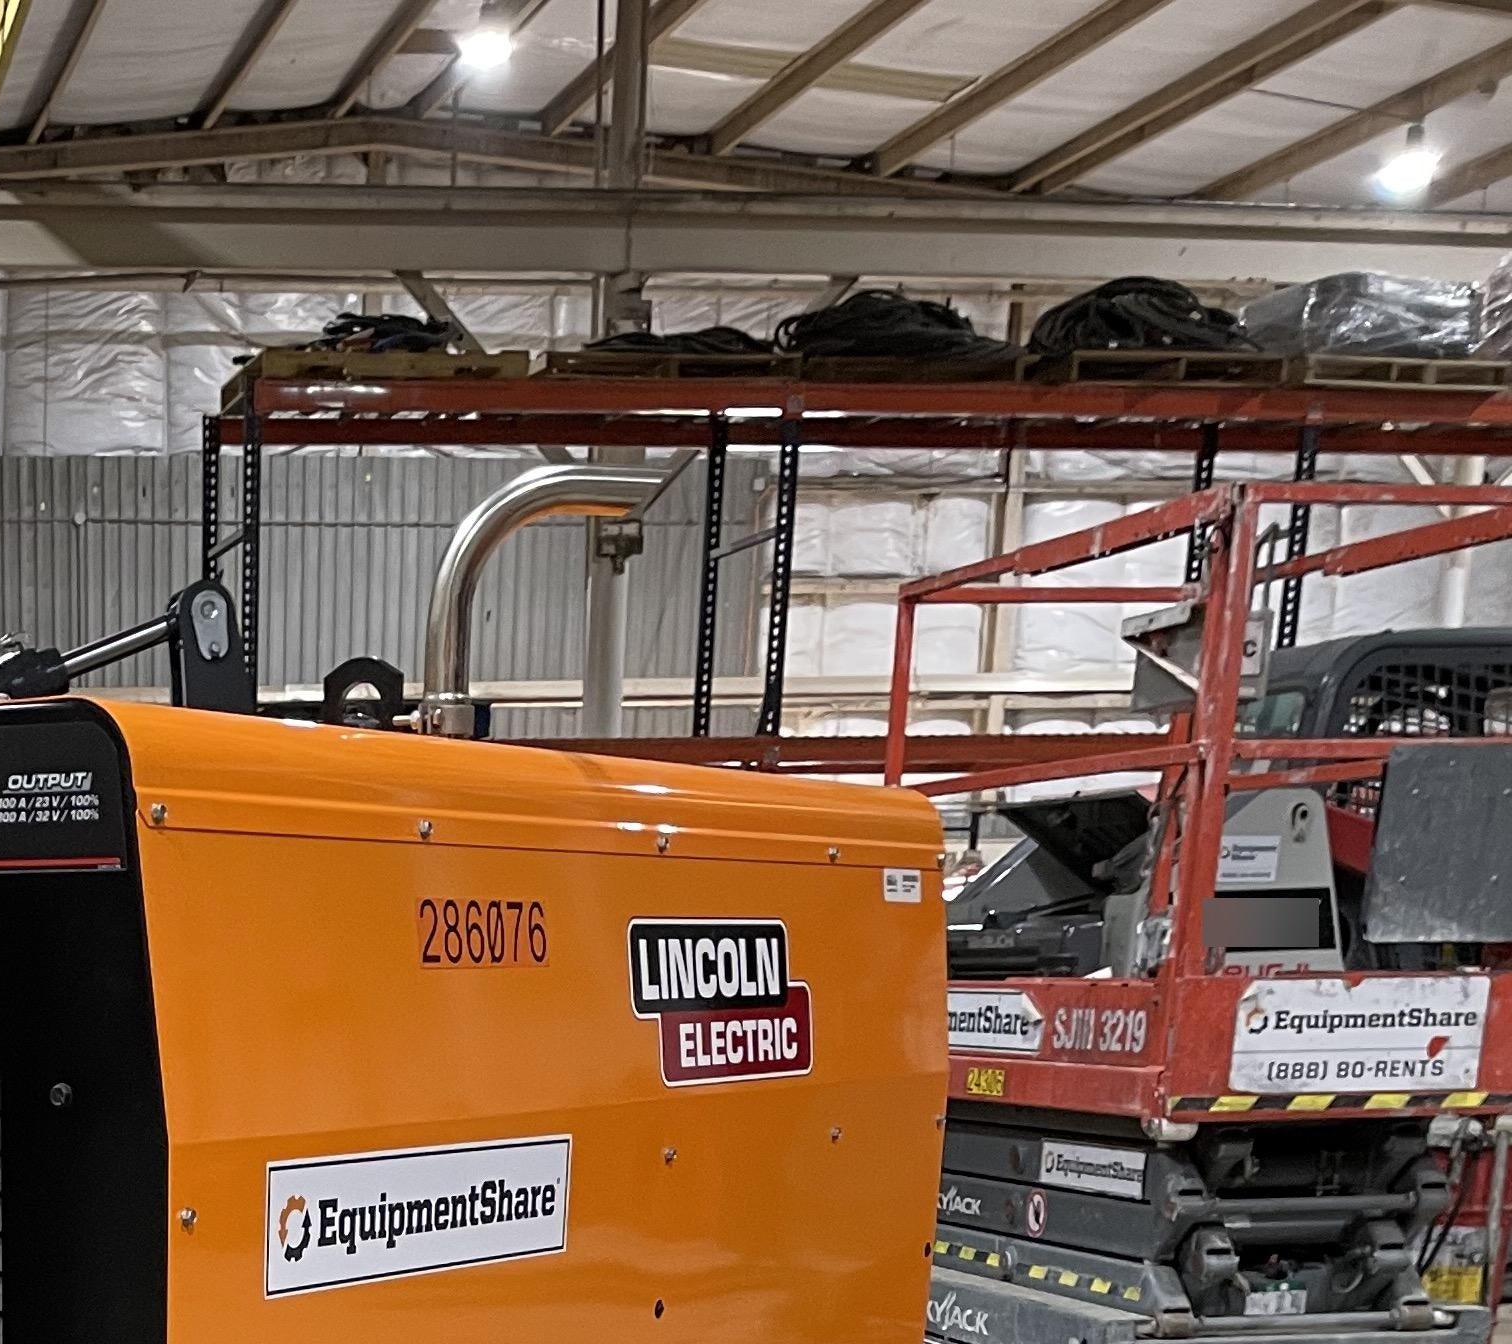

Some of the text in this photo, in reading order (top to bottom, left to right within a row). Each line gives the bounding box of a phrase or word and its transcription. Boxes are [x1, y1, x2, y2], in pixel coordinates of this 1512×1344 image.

[8, 772, 87, 789] OUTPUT
[419, 899, 547, 964] 286076
[639, 938, 780, 1000] LINCOLN
[679, 1017, 798, 1067] ELECTRIC
[1099, 1009, 1147, 1053] 3219
[1273, 1009, 1478, 1034] EquipmentShare
[1267, 1060, 1444, 1081] (888) 80-RENTS
[317, 1179, 555, 1255] EquipmentShare
